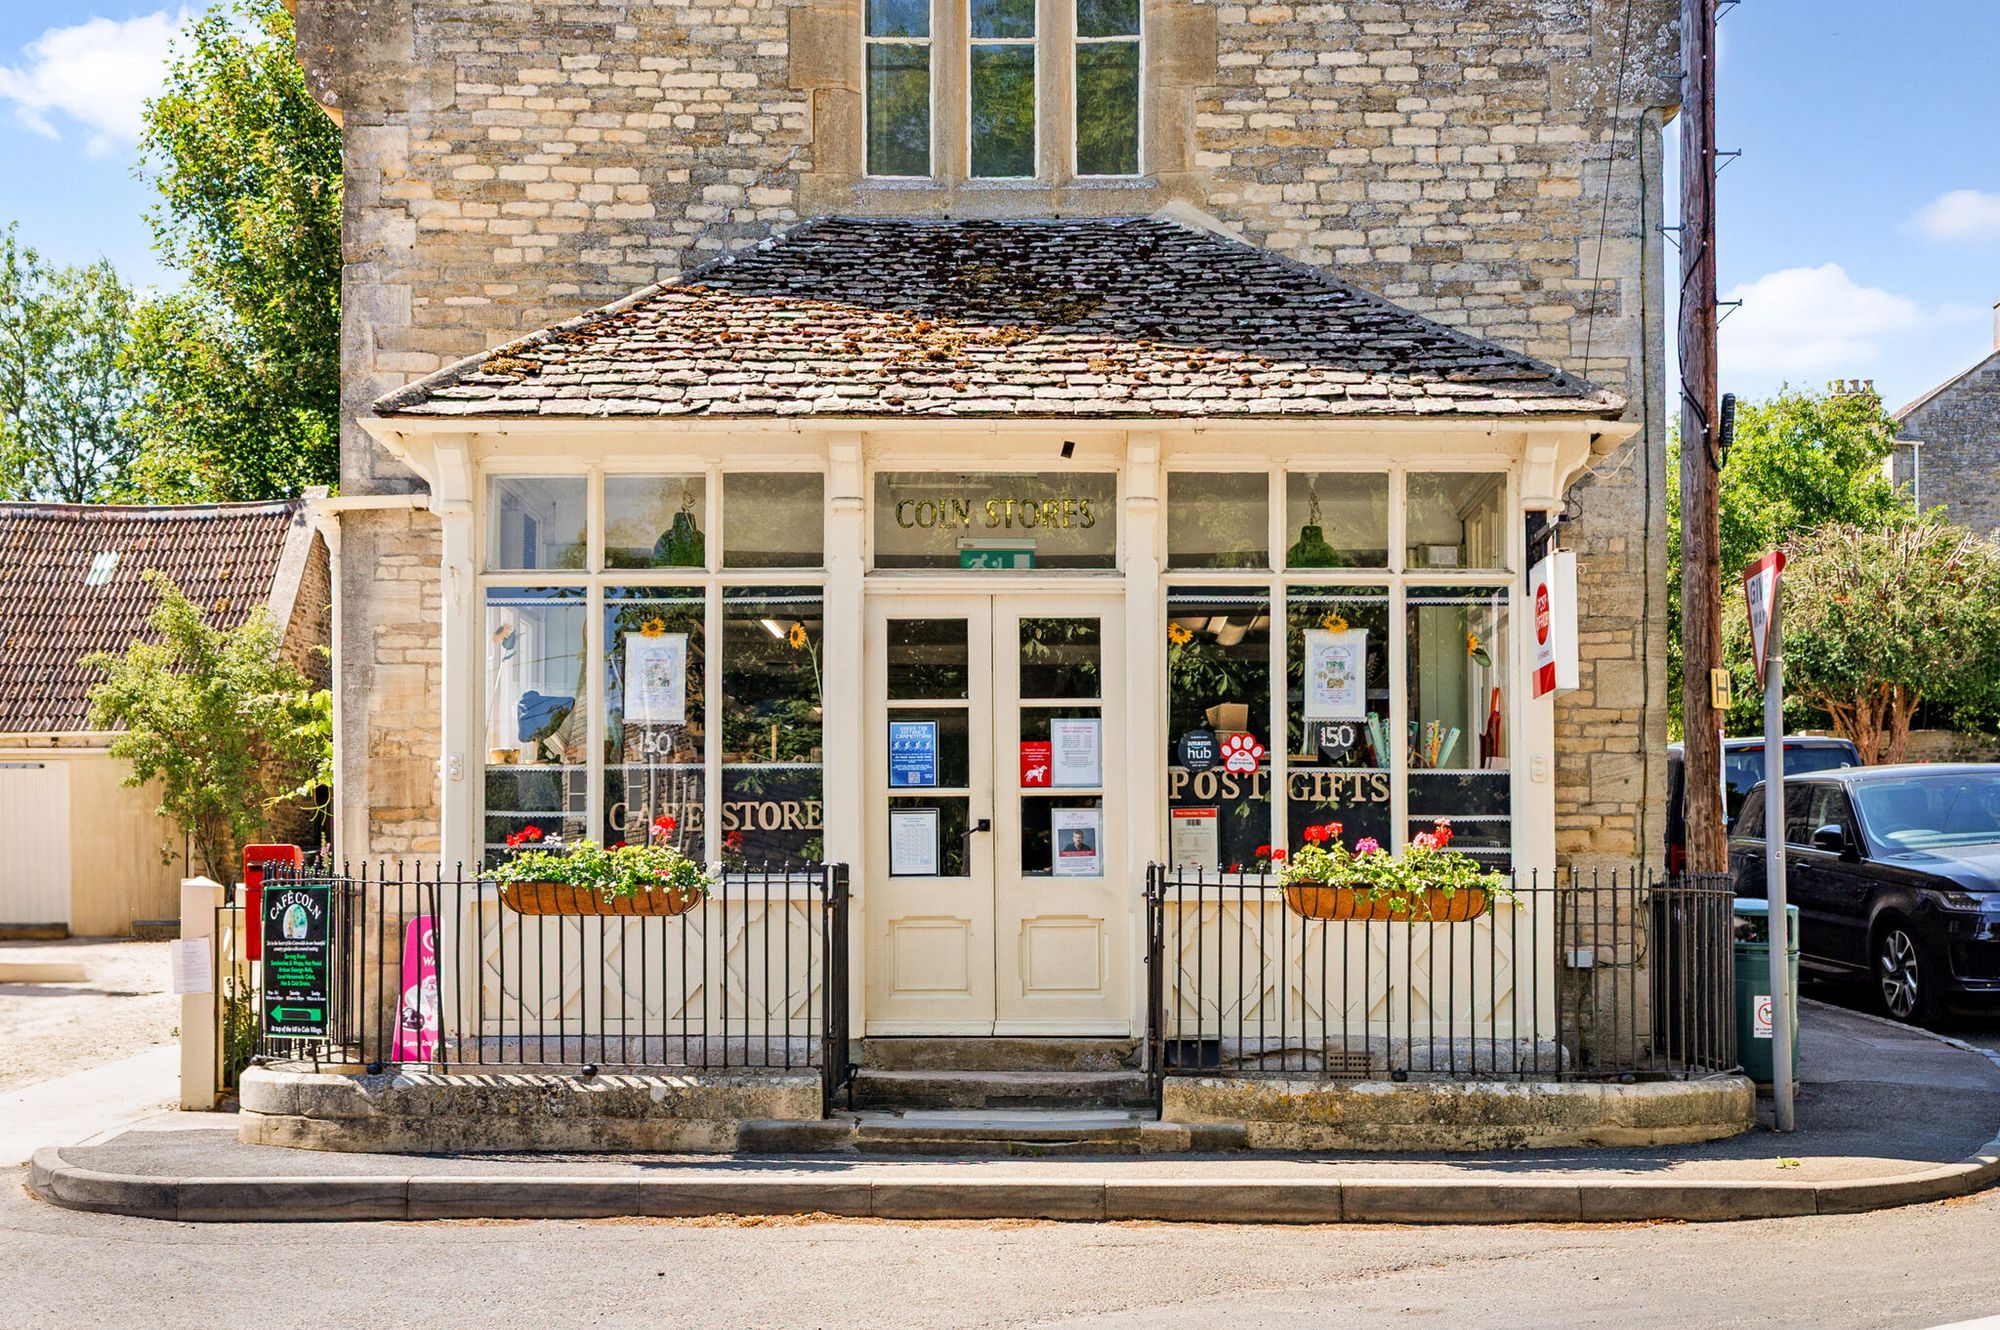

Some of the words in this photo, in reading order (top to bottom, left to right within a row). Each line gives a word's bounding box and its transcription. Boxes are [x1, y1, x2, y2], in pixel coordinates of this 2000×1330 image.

[895, 499, 970, 529] COLN
[984, 499, 1096, 529] STORES
[1537, 593, 1547, 612] POST
[1750, 574, 1768, 606] GIV
[1715, 673, 1729, 705] H
[1187, 740, 1211, 749] amazon
[1320, 725, 1355, 747] 150
[1187, 747, 1212, 759] hub
[1169, 771, 1268, 799] POST
[1288, 772, 1390, 801] GIFTS
[722, 801, 823, 831] STORE
[270, 890, 294, 920] CAFÉ
[295, 892, 322, 920] COLN
